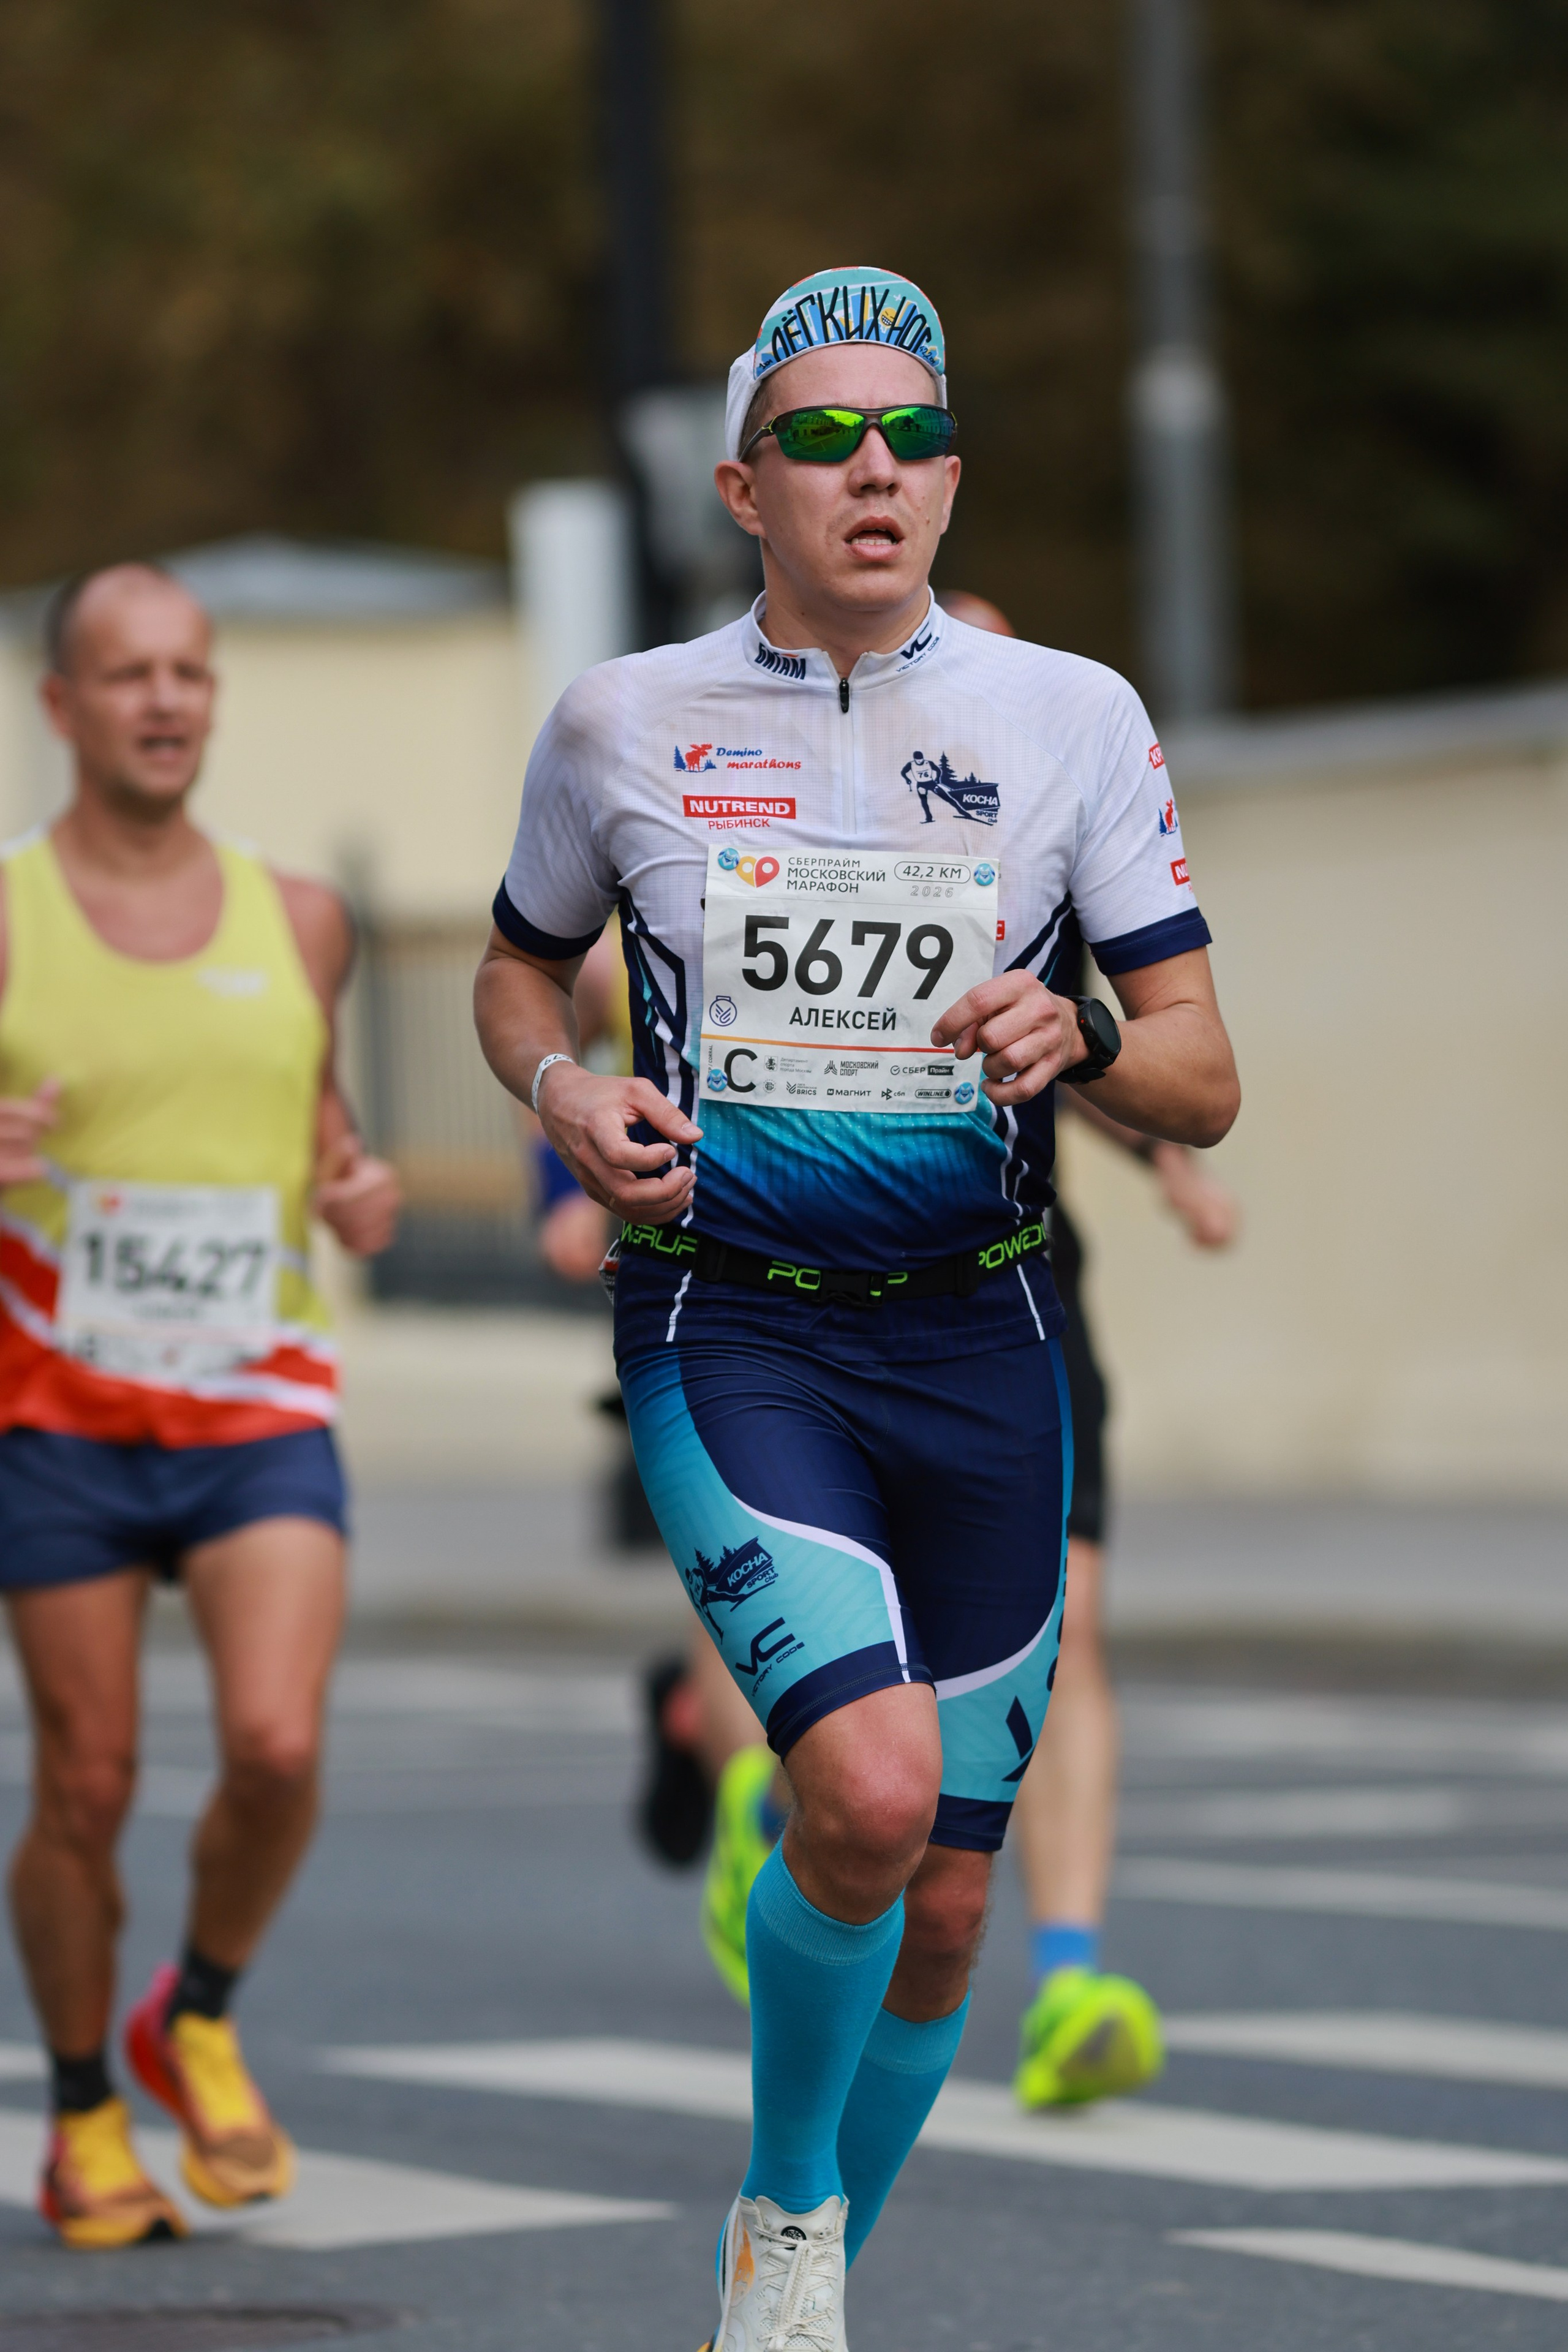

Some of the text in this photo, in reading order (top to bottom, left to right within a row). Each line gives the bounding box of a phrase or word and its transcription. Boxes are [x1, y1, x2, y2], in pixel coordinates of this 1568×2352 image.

[896, 652, 926, 672] VICTORY
[716, 747, 763, 757] Demino
[726, 759, 802, 770] marathons
[689, 800, 790, 815] NUTREND
[976, 810, 998, 818] SPORT
[708, 818, 771, 830] РЫБИНСК
[788, 857, 860, 868] СБЕРПРАЙМ
[787, 867, 886, 882] МОСКОВСКИЙ
[902, 865, 934, 878] 42,2
[786, 880, 859, 893] МАРАФОН
[910, 885, 954, 898] 2026
[742, 914, 954, 1000] 5679
[789, 1006, 897, 1031] АЛЕКСЕЙ
[840, 1060, 879, 1069] МОСКОВСКИЙ
[81, 1232, 268, 1298] 15427
[747, 1566, 775, 1588] SPORT
[764, 1572, 778, 1583] Club
